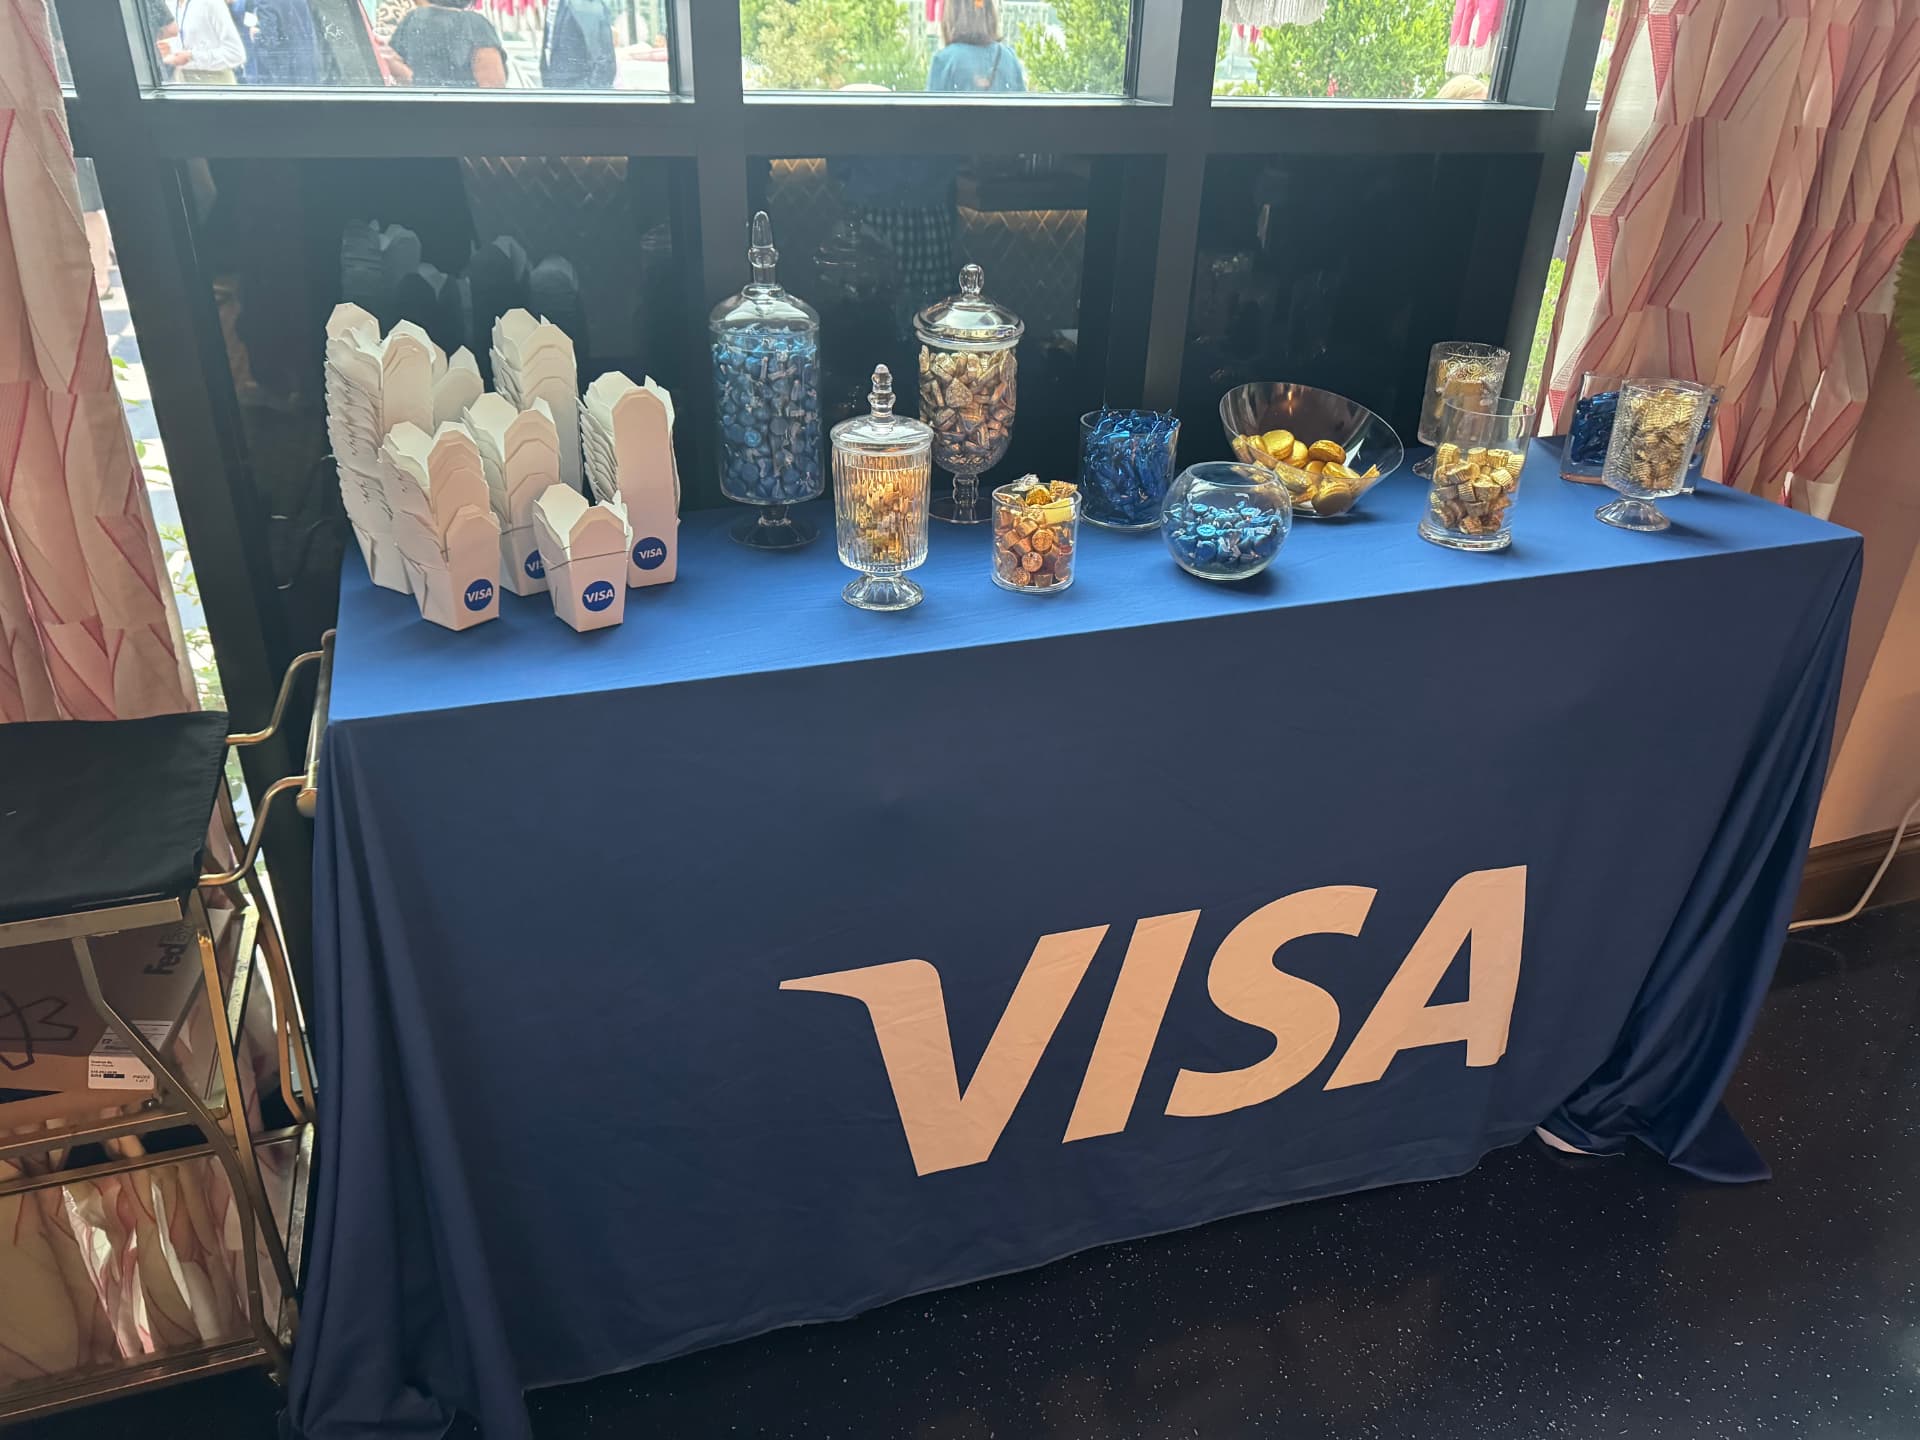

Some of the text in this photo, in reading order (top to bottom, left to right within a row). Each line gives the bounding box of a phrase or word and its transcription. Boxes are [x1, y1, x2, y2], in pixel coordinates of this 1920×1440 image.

[638, 547, 663, 560] VISA
[466, 587, 493, 602] VISA
[584, 588, 615, 603] VISA
[779, 865, 1527, 1176] VISA
